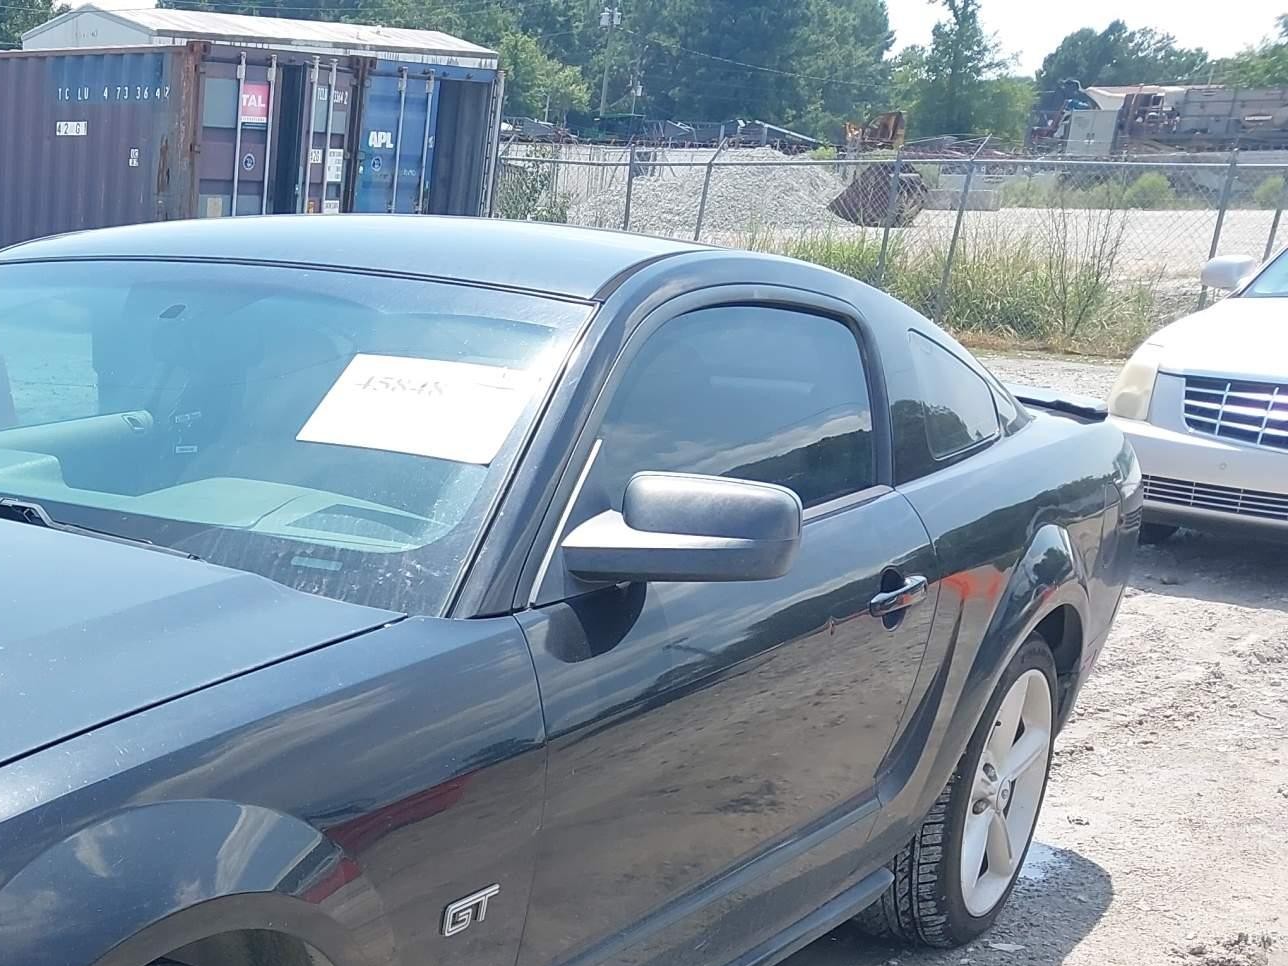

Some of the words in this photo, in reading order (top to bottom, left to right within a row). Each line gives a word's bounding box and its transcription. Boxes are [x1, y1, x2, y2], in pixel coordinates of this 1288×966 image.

[242, 94, 266, 108] TAL
[368, 131, 394, 149] APL
[442, 883, 501, 937] GT
